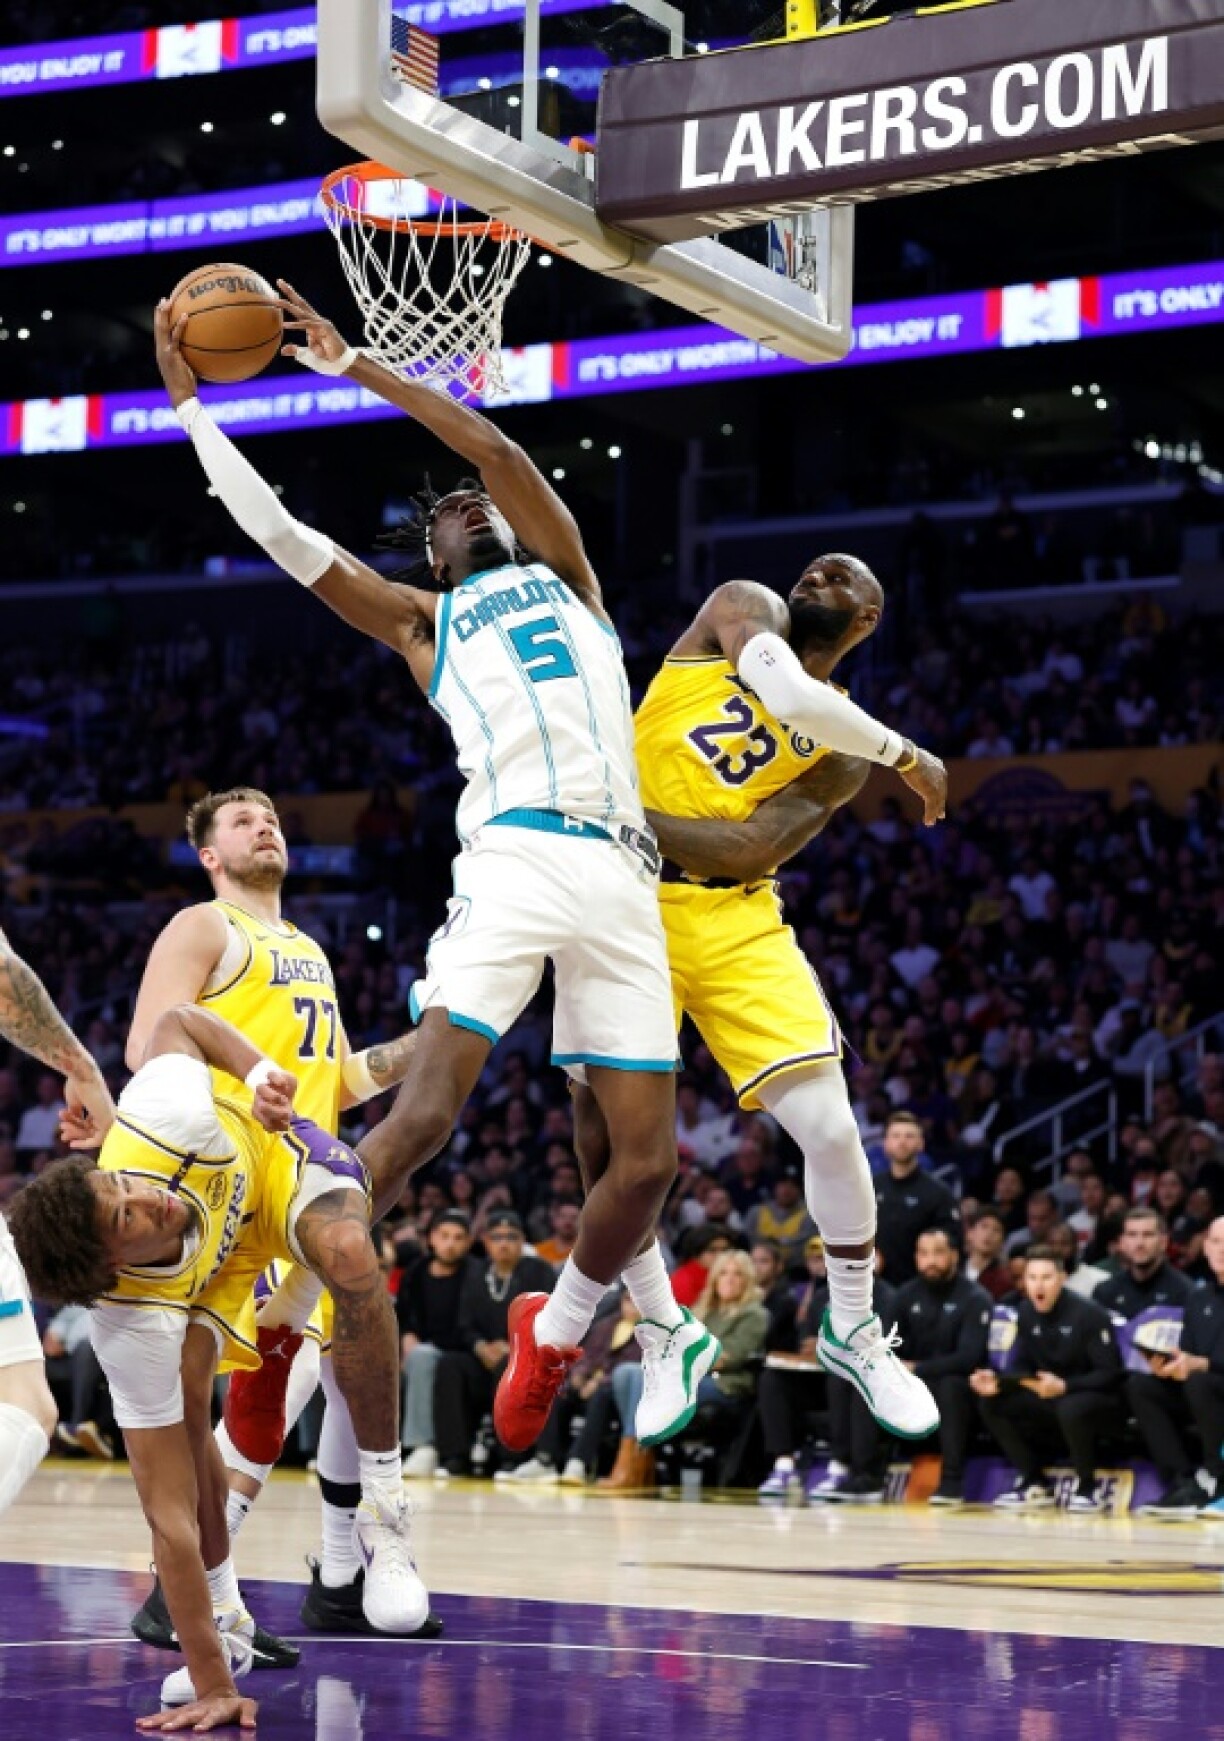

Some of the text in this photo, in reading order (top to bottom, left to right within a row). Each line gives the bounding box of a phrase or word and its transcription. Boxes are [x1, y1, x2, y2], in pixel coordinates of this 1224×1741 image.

[680, 36, 1169, 189] LAKERS.COM
[1113, 282, 1224, 318] IT'S ONLY
[578, 353, 617, 382] IT'S
[620, 350, 672, 377] ONLY
[676, 339, 757, 371] WORTH
[858, 316, 934, 349] ENJOY
[937, 313, 963, 340] IT
[508, 616, 578, 682] 5
[686, 694, 778, 786] 23
[269, 949, 335, 988] LAKER
[293, 997, 336, 1058] 77
